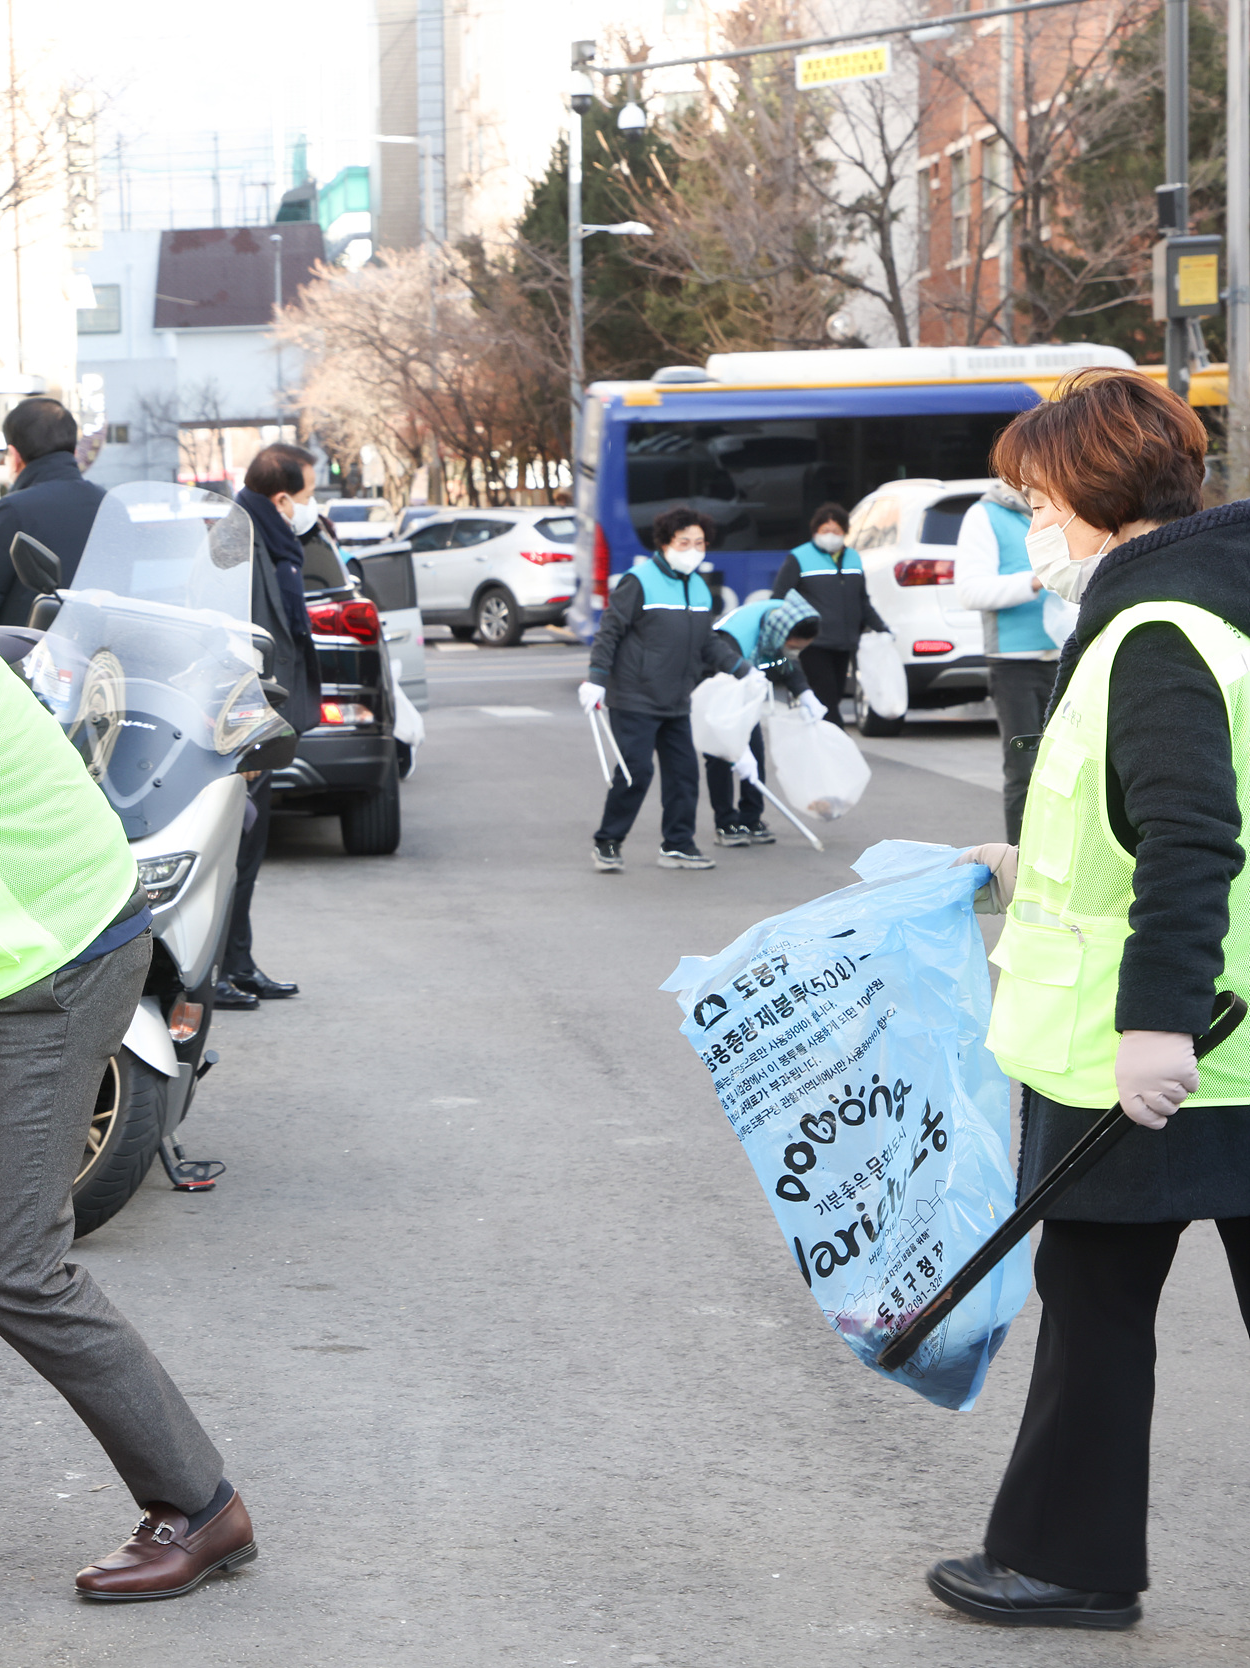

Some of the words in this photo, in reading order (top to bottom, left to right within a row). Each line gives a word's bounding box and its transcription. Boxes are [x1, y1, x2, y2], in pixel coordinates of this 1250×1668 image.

[732, 954, 789, 1001] 도봉구
[766, 1060, 780, 1073] 이
[778, 1043, 808, 1067] 봉투를
[769, 1056, 822, 1092] 부과됩니다.
